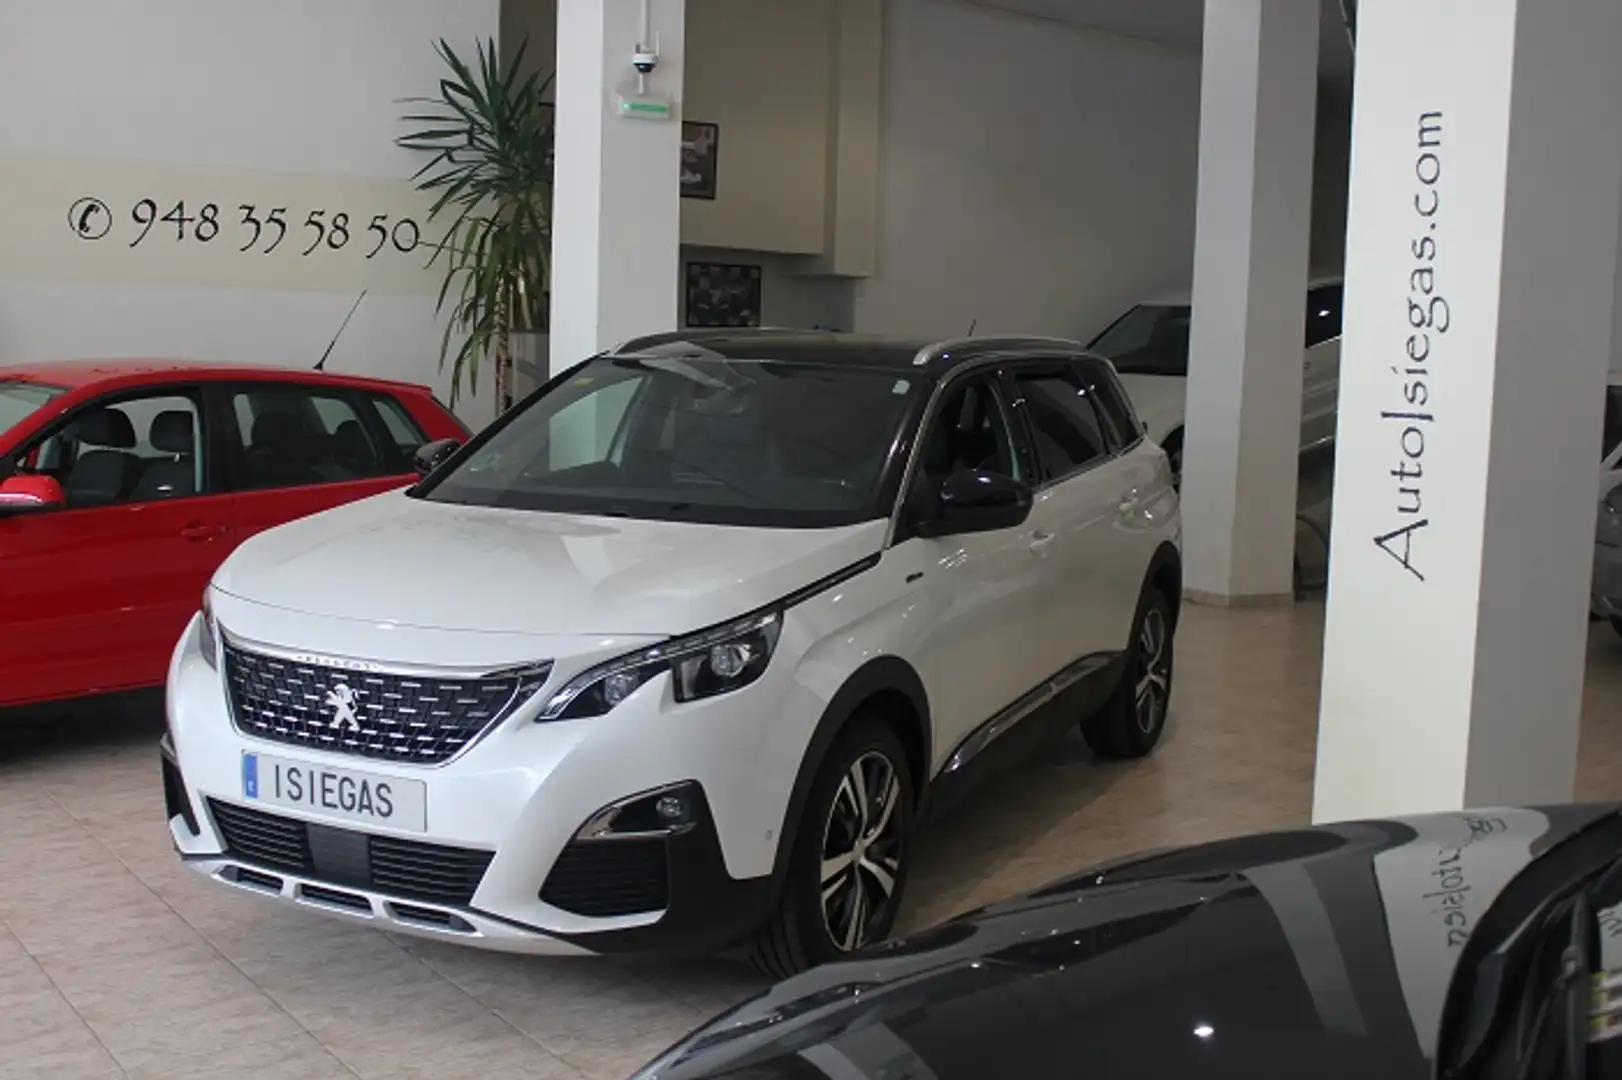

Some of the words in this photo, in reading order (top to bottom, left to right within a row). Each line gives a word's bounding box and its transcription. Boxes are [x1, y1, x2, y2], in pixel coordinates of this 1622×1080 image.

[128, 197, 220, 249] 948
[238, 203, 287, 254] 35
[301, 209, 350, 257] 58
[365, 213, 420, 260] 50
[1373, 110, 1451, 583] AutoIsiegas.com
[274, 763, 394, 819] ISIEGAS
